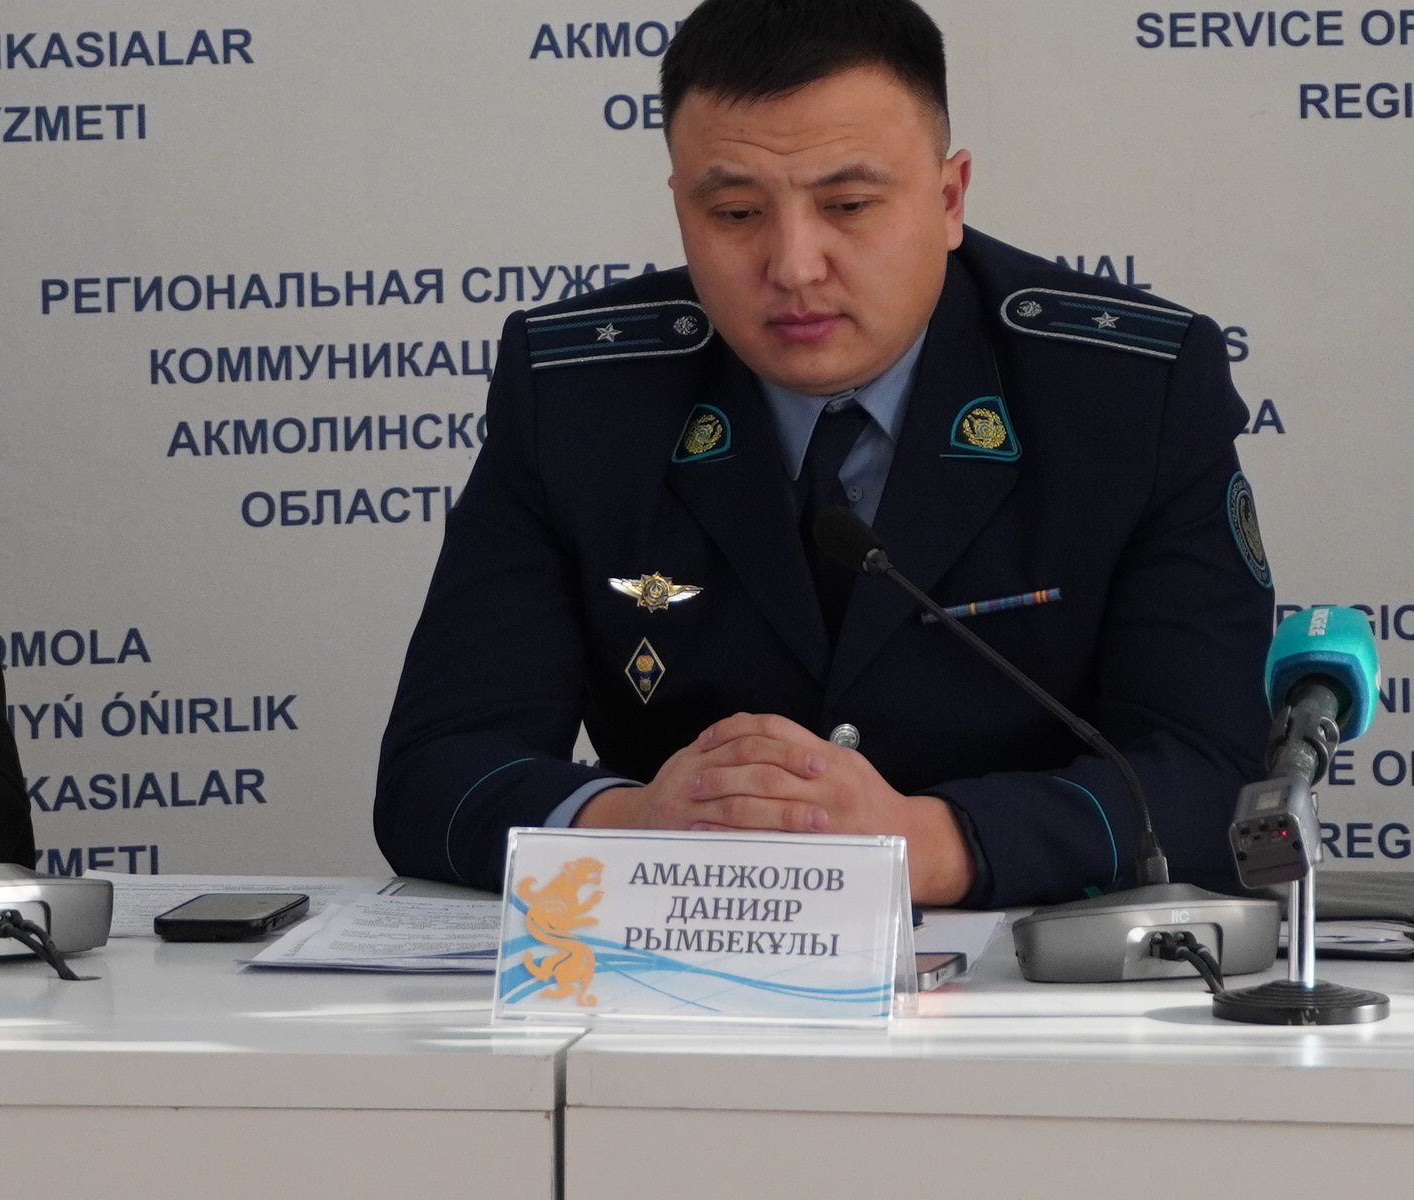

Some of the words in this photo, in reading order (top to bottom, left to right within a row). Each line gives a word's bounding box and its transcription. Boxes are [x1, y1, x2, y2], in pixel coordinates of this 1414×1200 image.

[1135, 9, 1343, 49] SERVICE
[40, 267, 445, 314] РЕГИОНАЛЬНАЯ
[149, 338, 501, 384] КОММУНИКАЦ
[168, 411, 488, 458] АКМОЛИНСК
[99, 690, 299, 738] ÓŃIRLIK
[627, 861, 846, 892] АМАНЖОЛОВ
[665, 895, 804, 925] ДАНИЯР
[621, 926, 842, 957] РЫМБЕКҰЛЫ
